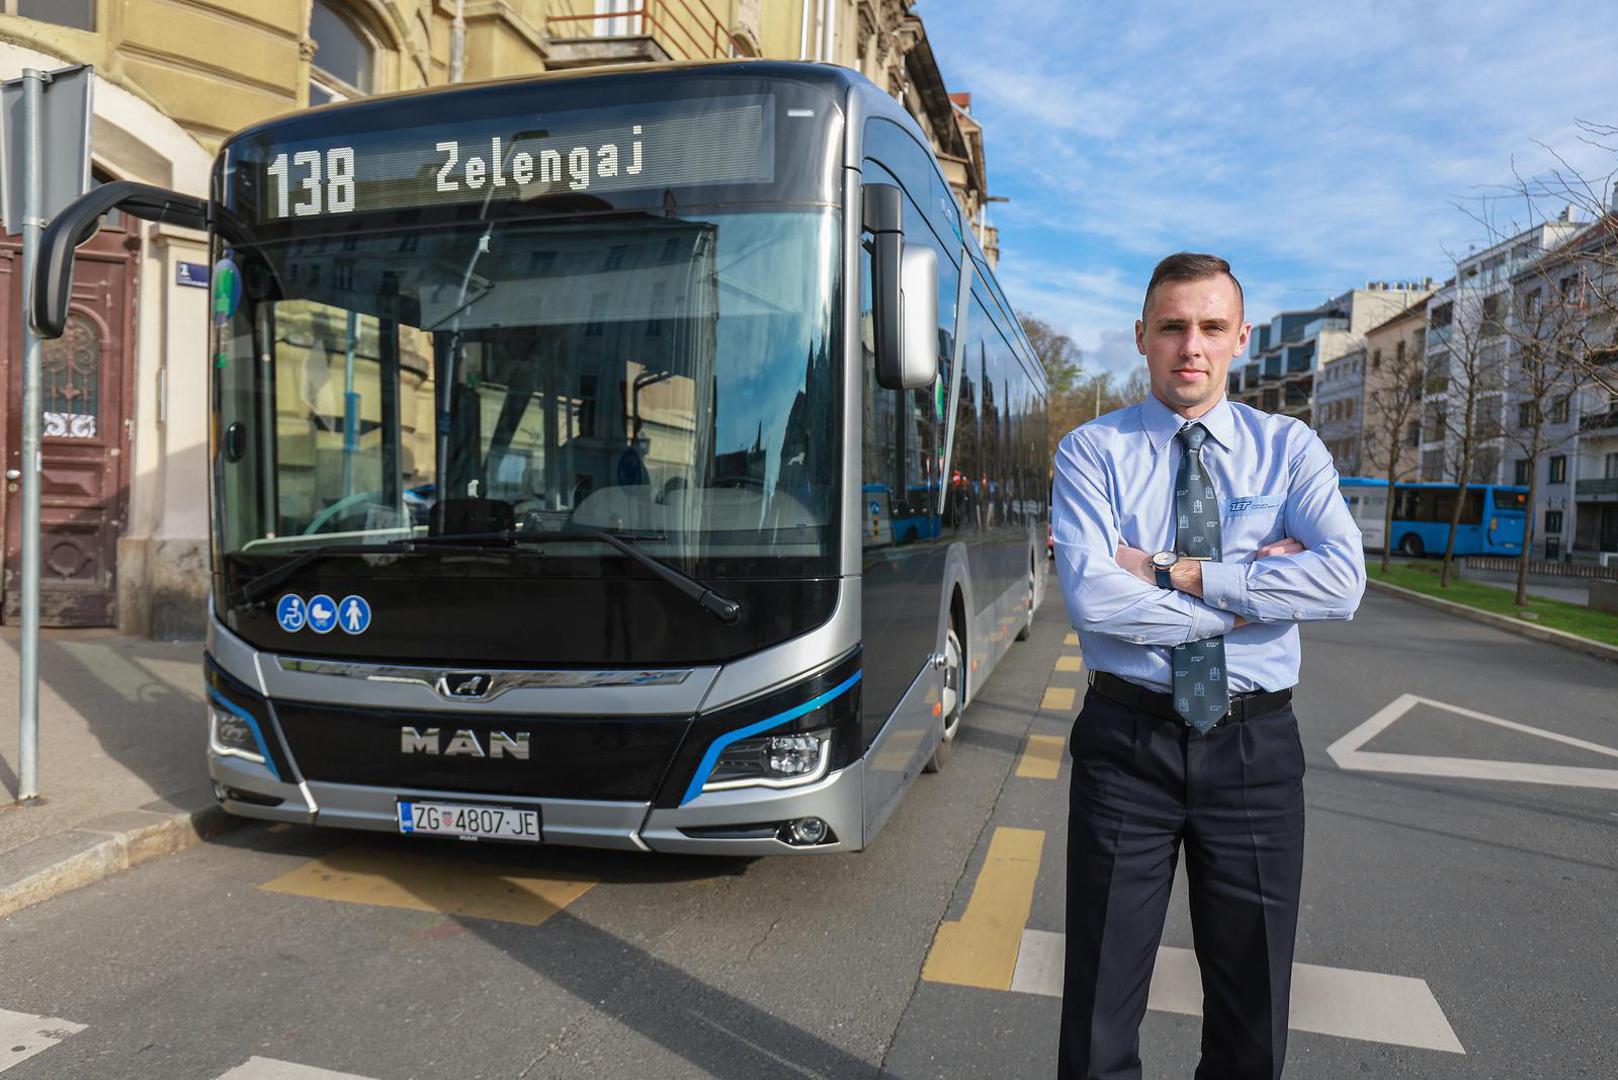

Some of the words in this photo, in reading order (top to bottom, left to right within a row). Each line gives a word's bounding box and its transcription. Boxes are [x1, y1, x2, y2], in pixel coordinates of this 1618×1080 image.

[267, 147, 356, 217] 138
[436, 125, 643, 191] Zelengaj
[401, 726, 531, 760] MAN
[414, 807, 440, 831] ZG
